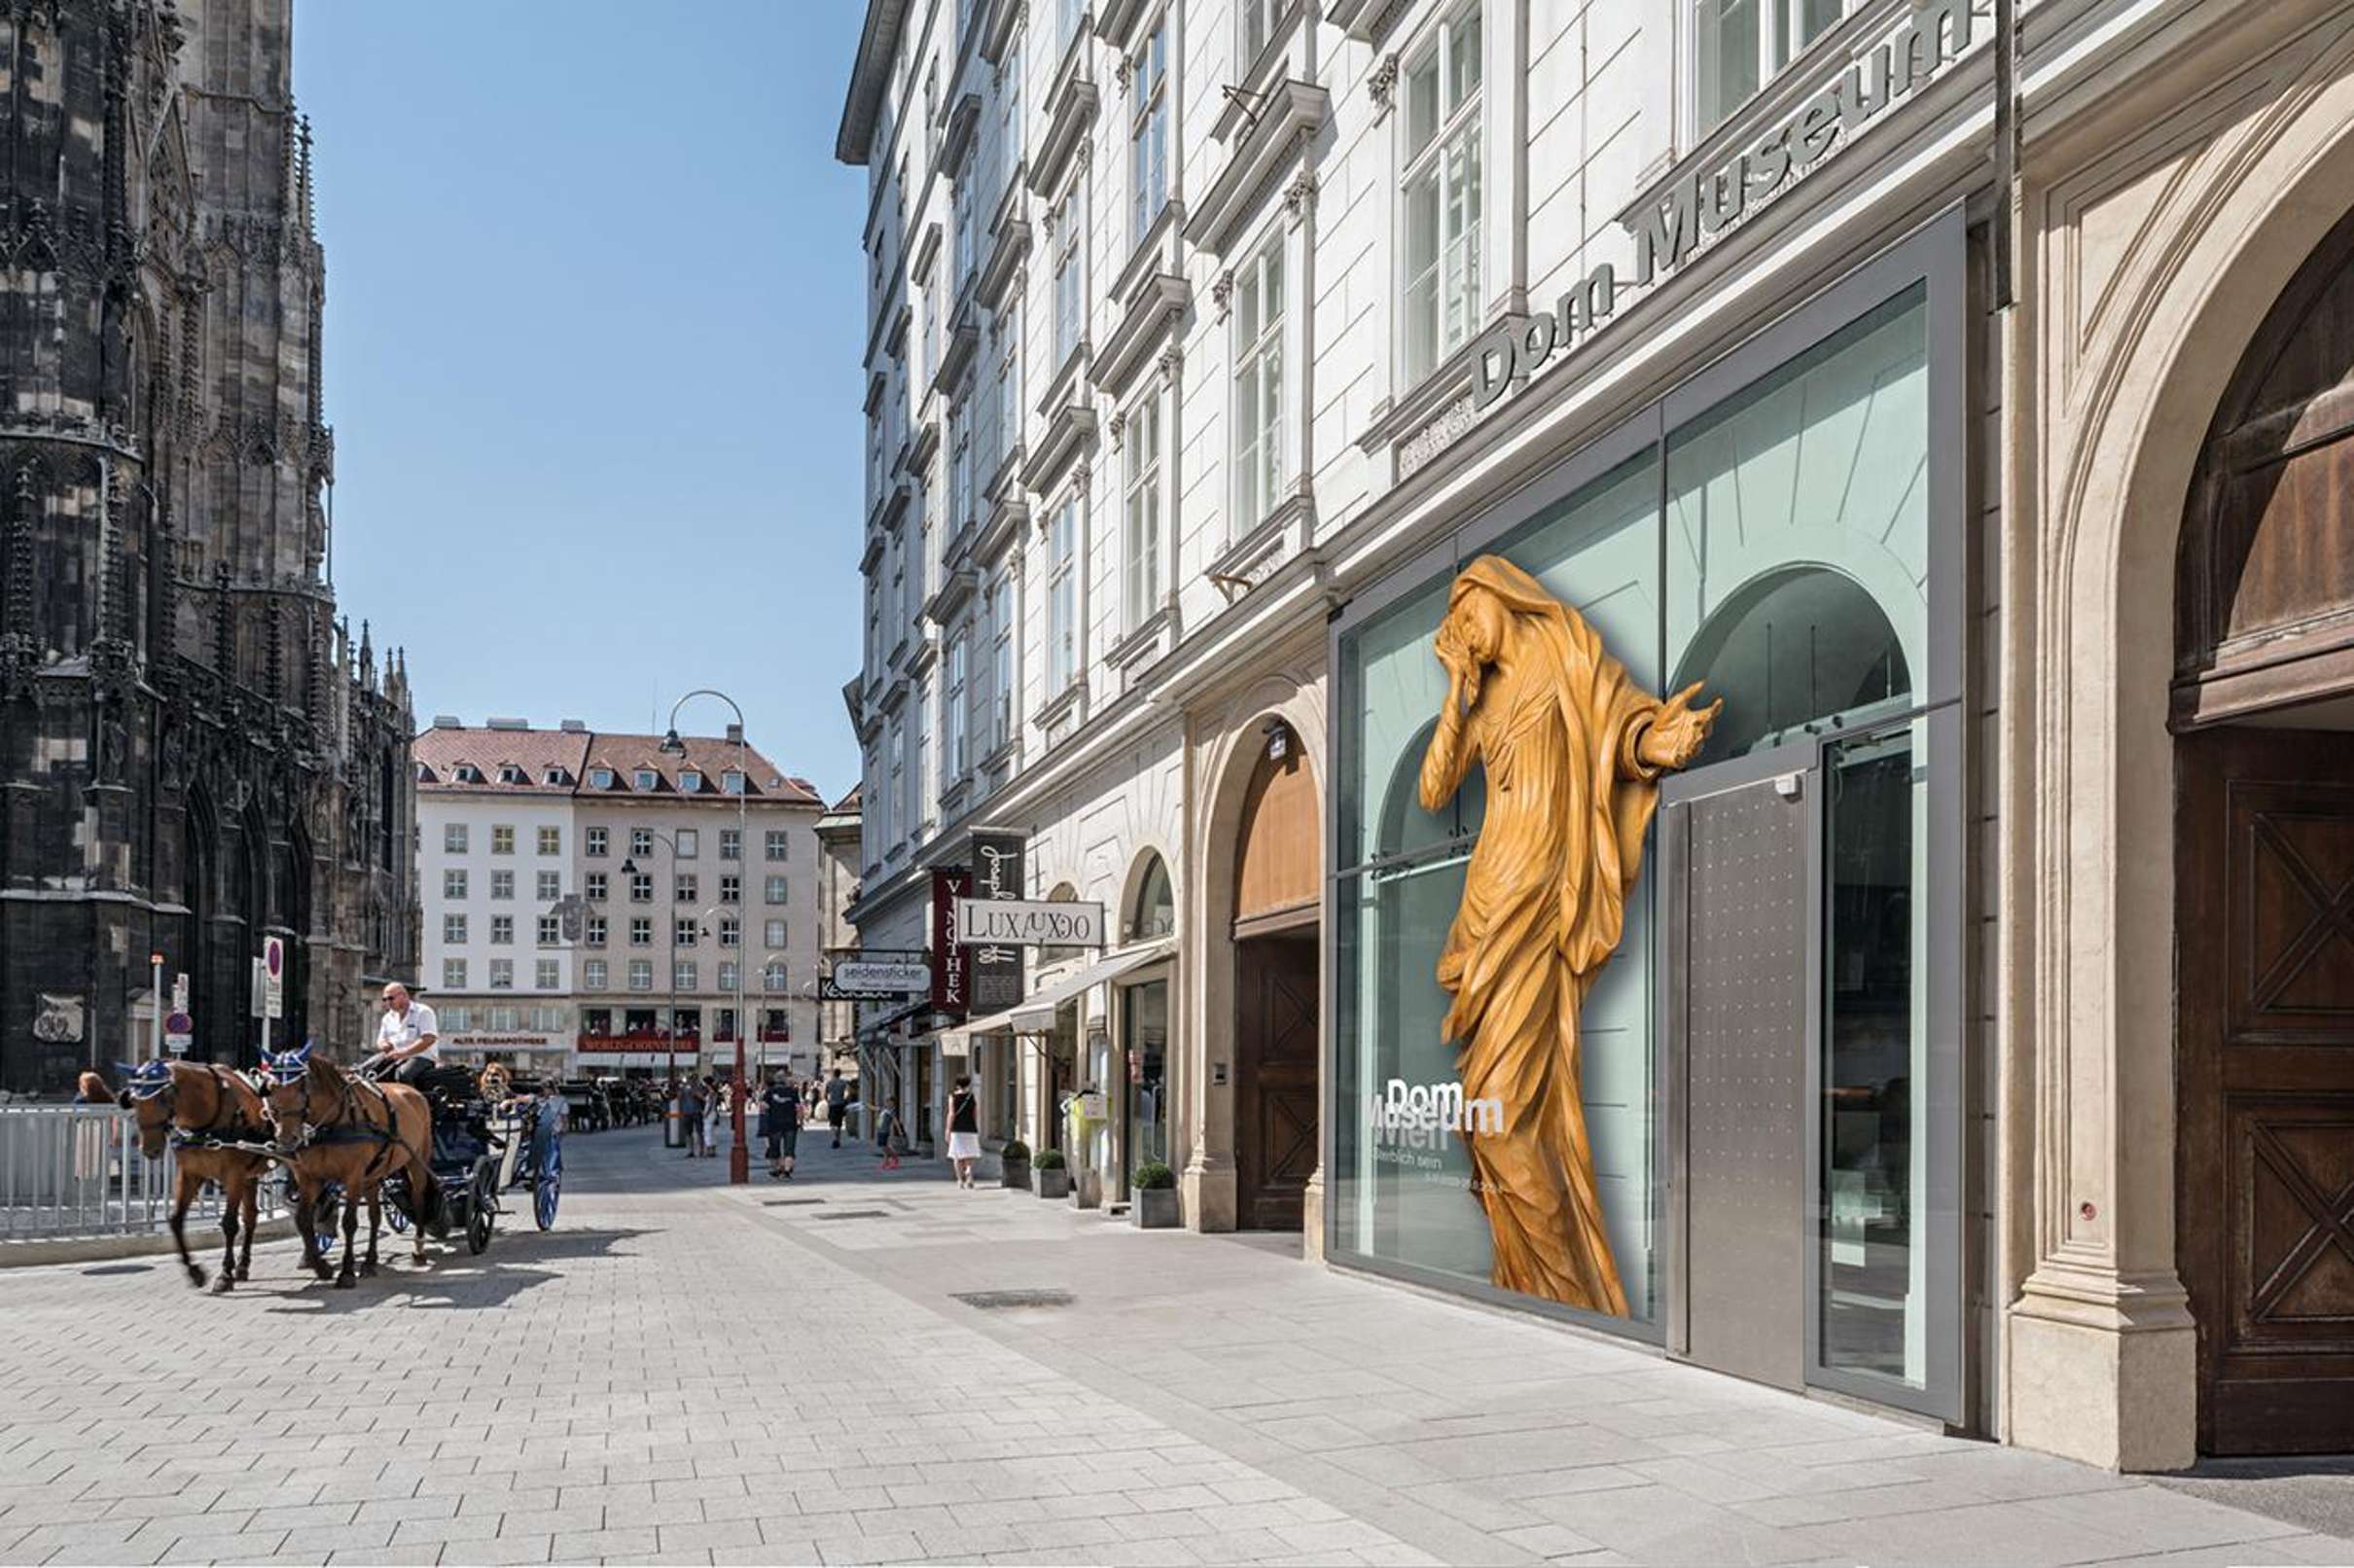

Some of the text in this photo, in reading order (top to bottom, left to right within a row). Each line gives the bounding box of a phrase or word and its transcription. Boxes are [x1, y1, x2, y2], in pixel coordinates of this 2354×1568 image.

[1471, 0, 1972, 410] Dom Museum
[1370, 1094, 1504, 1133] Museum
[1387, 1079, 1463, 1115] Dom
